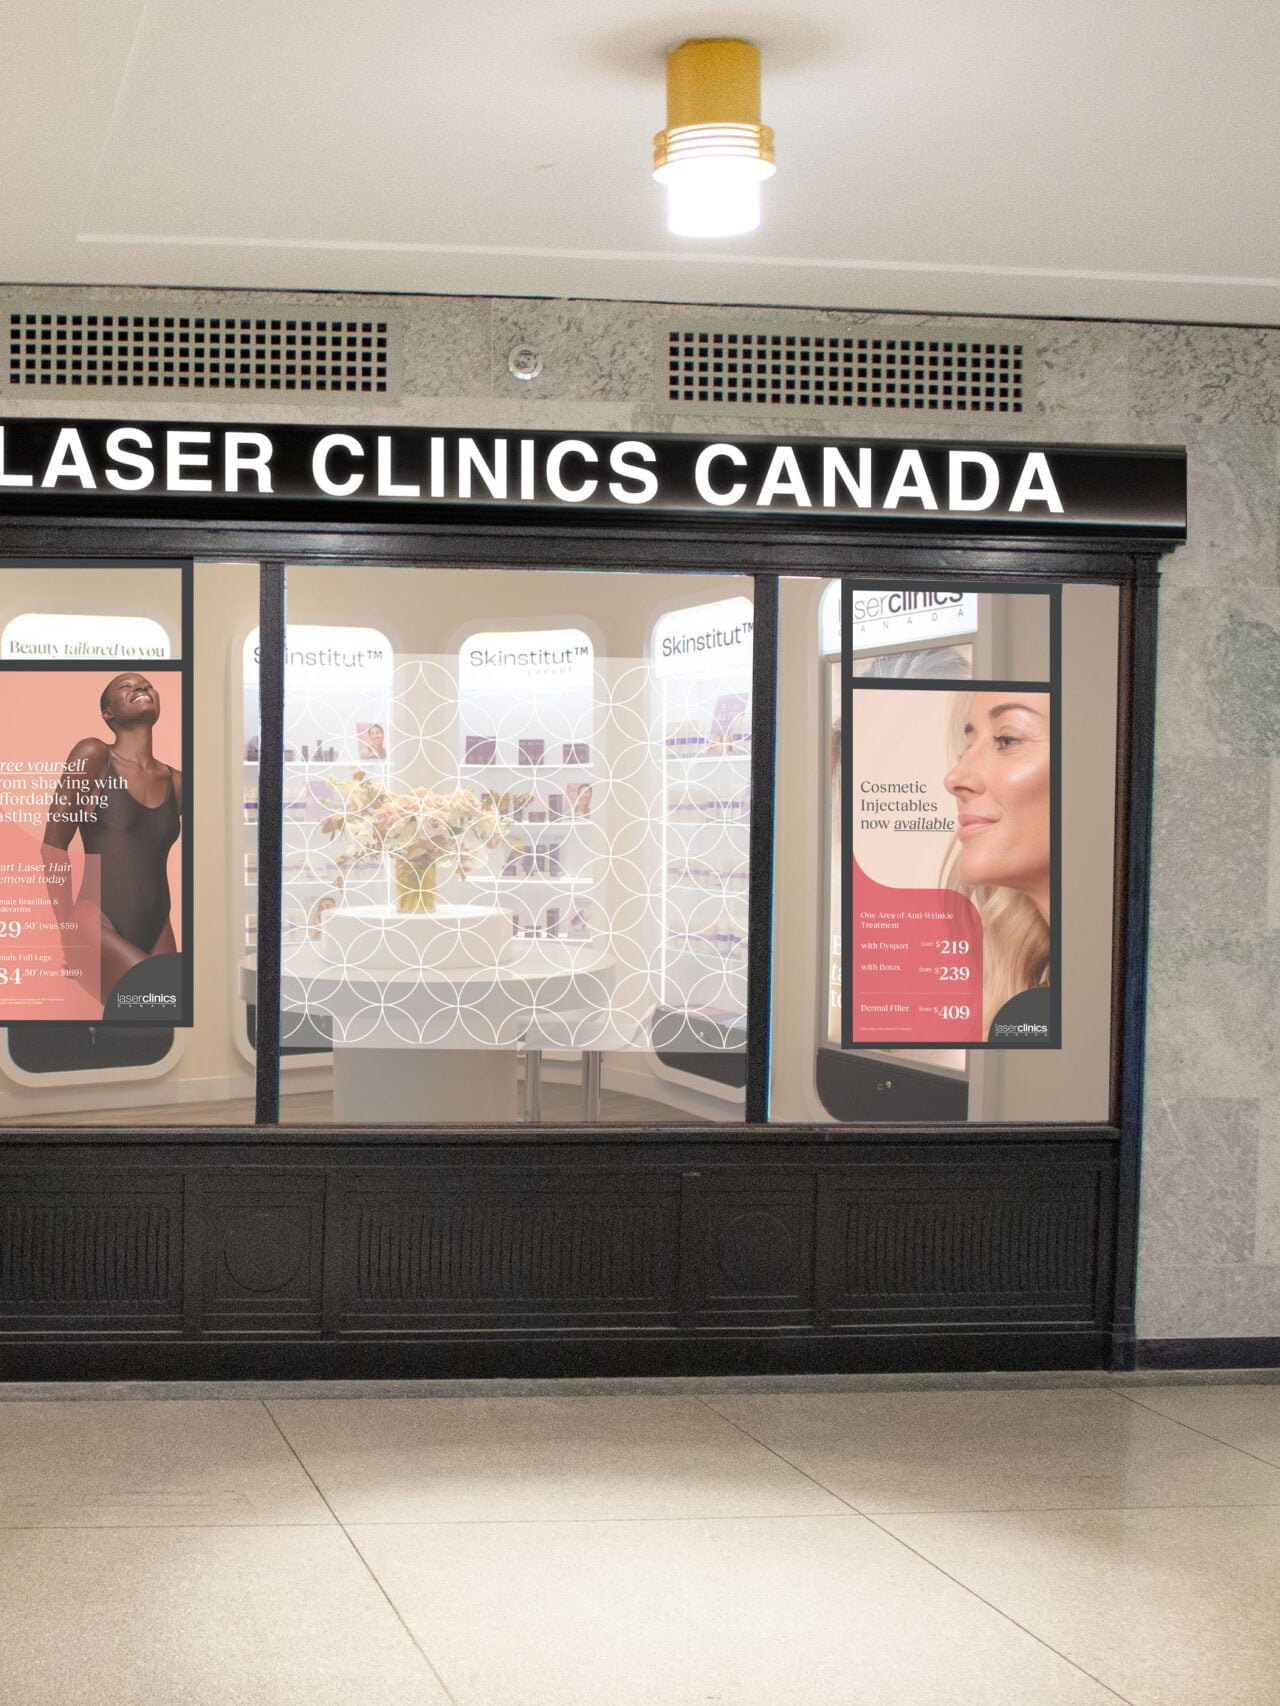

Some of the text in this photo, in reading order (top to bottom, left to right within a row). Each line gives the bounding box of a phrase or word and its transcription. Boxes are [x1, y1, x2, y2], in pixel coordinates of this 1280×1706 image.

[311, 433, 659, 504] CLINICS
[694, 442, 1064, 514] CANADA
[10, 640, 165, 660] Beauty tailored to you
[27, 759, 88, 775] yourself
[31, 776, 90, 792] shaving
[94, 776, 128, 789] with
[860, 781, 927, 794] Cosmetic
[76, 792, 109, 808] long
[860, 799, 938, 814] Injectables
[47, 809, 98, 823] results
[860, 818, 955, 831] now available
[18, 862, 46, 872] Laser
[49, 862, 72, 872] Hair
[38, 874, 68, 886] today
[861, 942, 878, 950] with
[880, 942, 909, 952] Dysport
[936, 940, 969, 954] $219
[34, 954, 52, 963] Legs
[934, 966, 970, 981] $239
[117, 992, 177, 1003] laserclinics
[861, 1004, 888, 1012] Dermal
[890, 1004, 910, 1012] Filler
[934, 1005, 970, 1020] $409
[995, 1023, 1048, 1032] laserclinics
